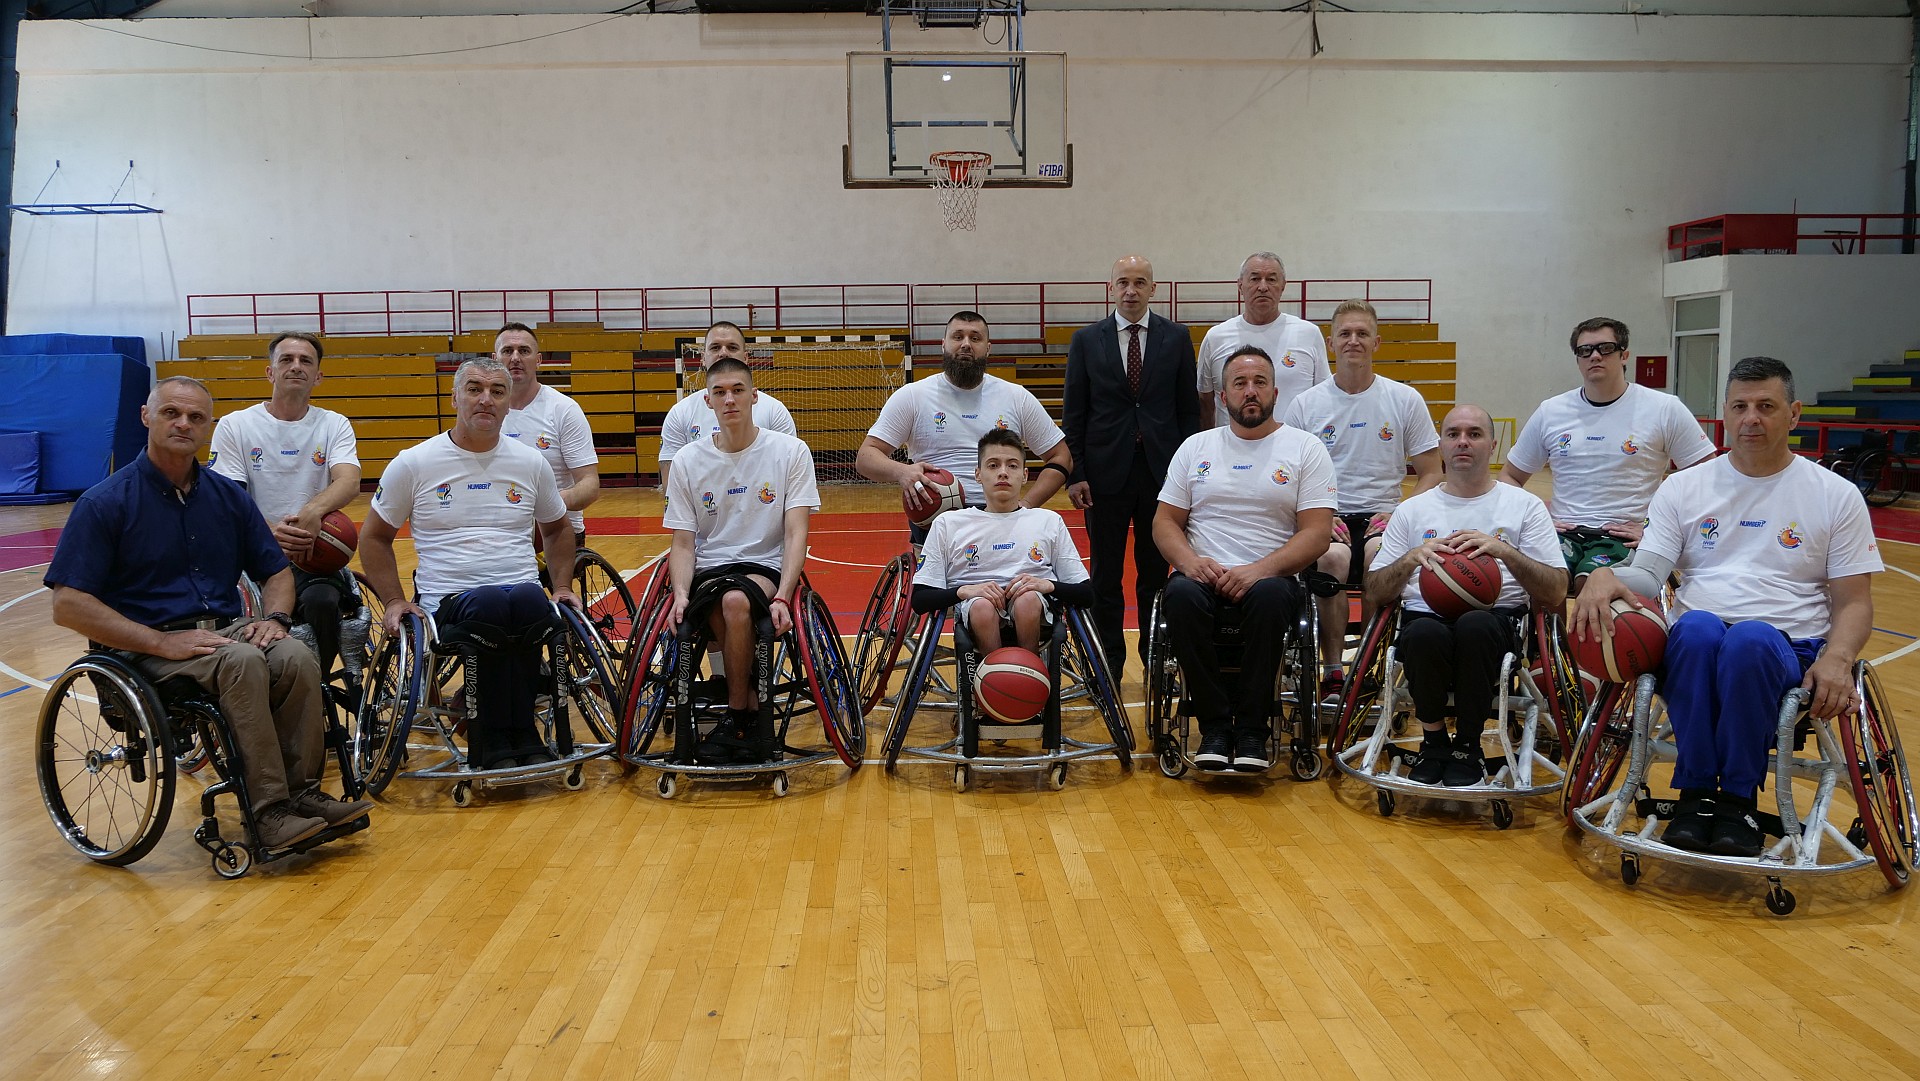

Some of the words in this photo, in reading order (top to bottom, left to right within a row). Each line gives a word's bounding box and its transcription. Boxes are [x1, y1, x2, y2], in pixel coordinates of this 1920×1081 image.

[1044, 164, 1063, 176] FIBA
[1646, 367, 1654, 377] H
[1451, 558, 1482, 587] molten
